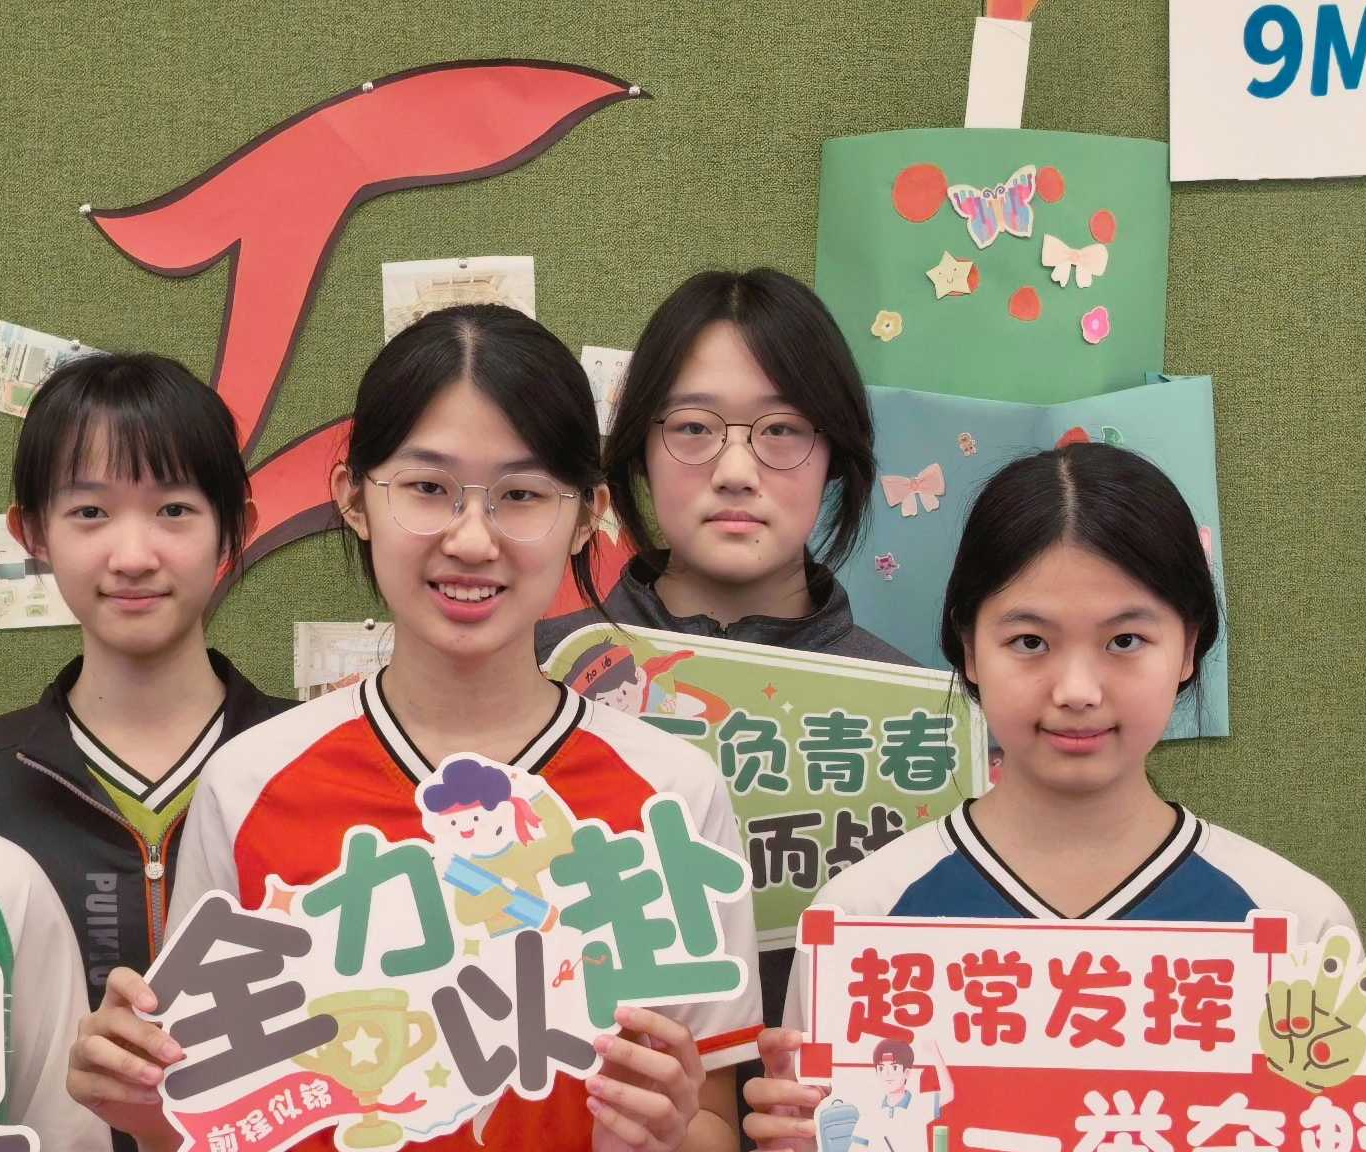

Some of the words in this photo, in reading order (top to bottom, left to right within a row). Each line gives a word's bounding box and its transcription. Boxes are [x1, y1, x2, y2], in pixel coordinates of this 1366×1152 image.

[146, 798, 746, 1101] 全力以赴
[845, 947, 1237, 1053] 超常发挥
